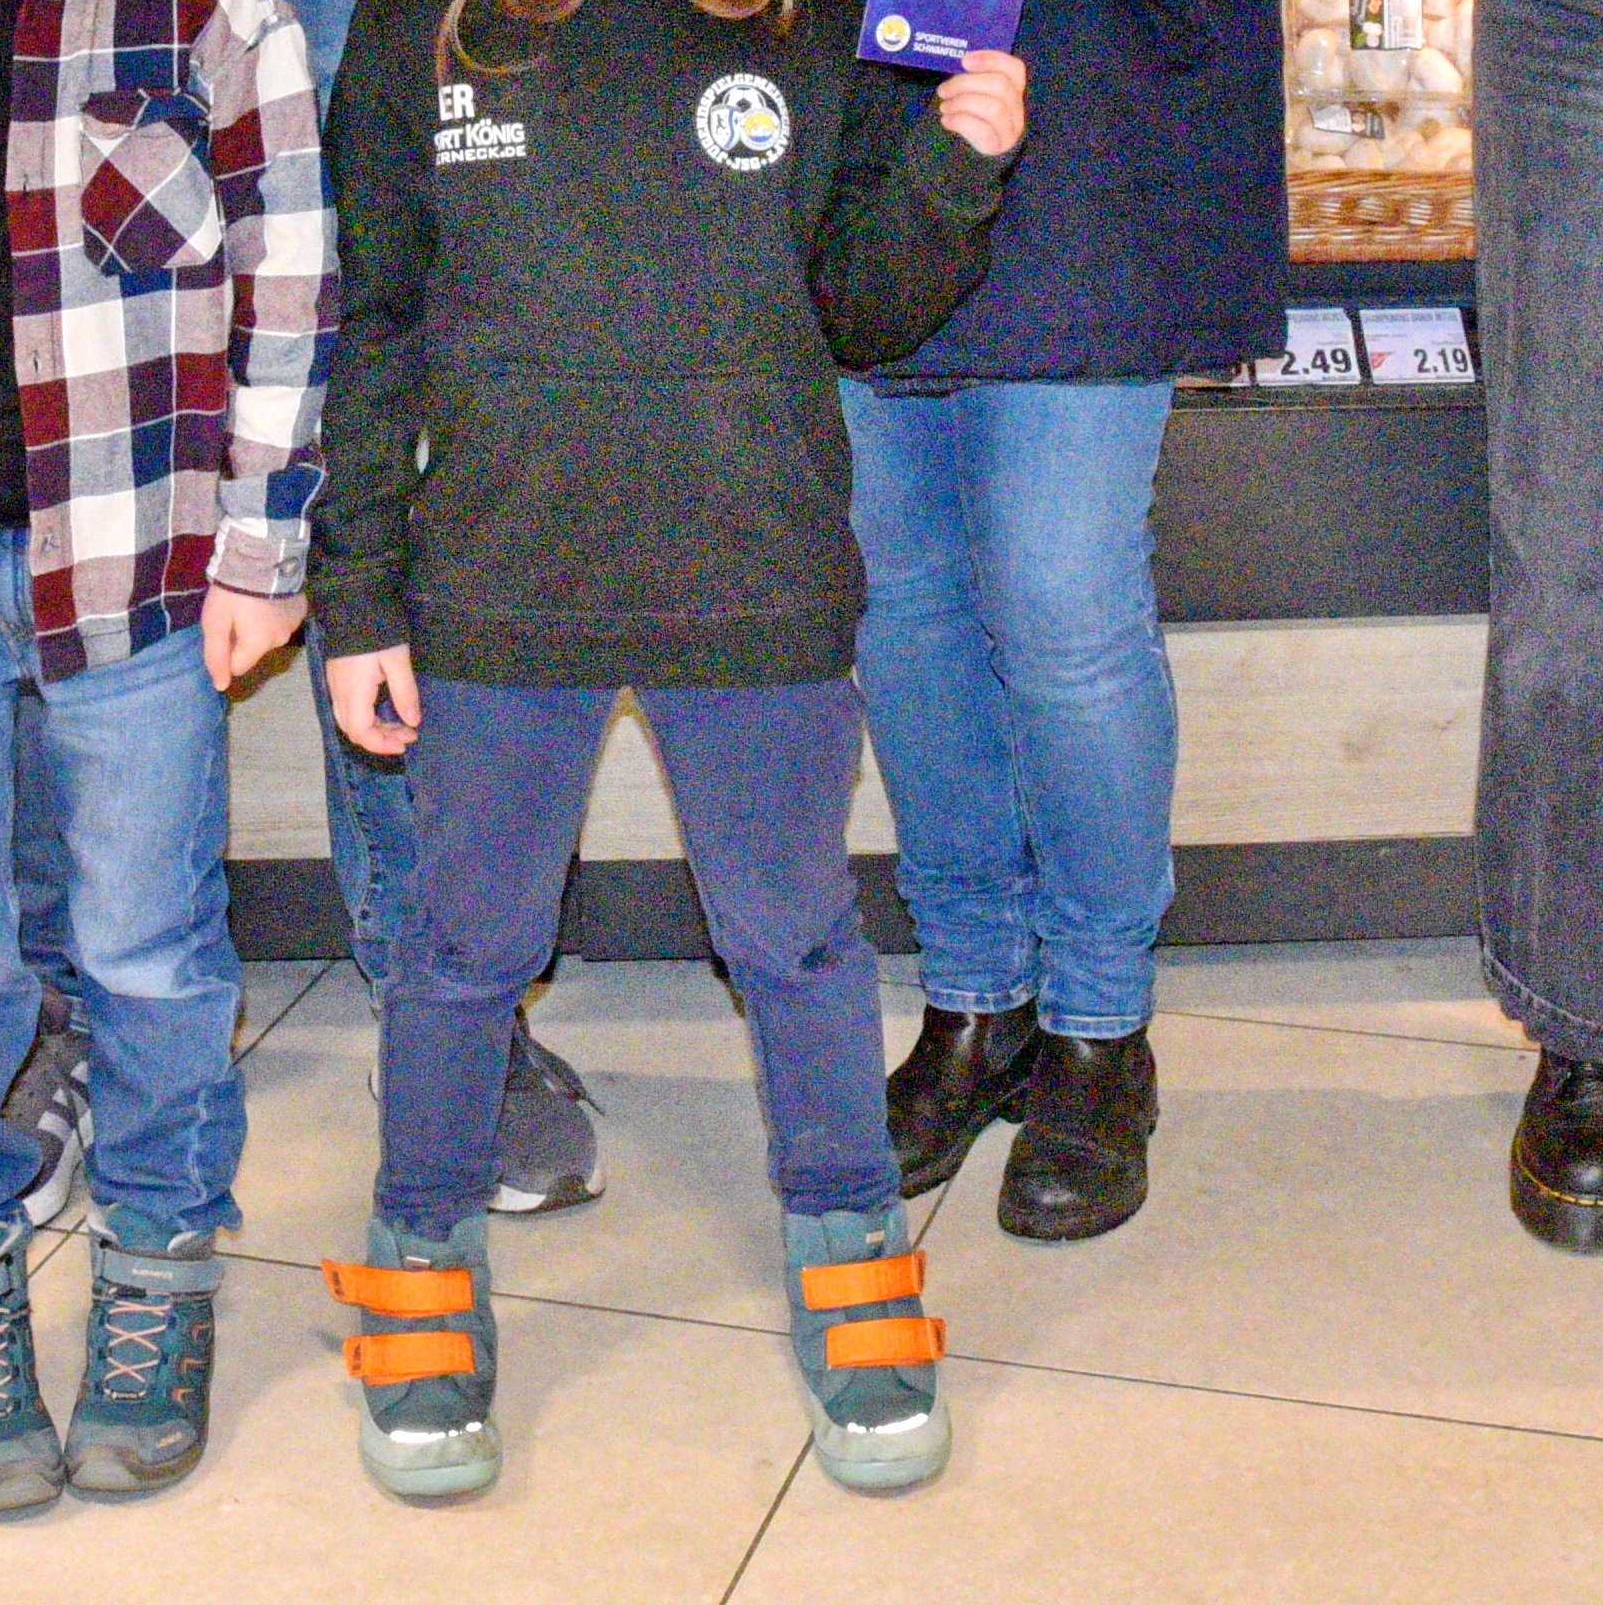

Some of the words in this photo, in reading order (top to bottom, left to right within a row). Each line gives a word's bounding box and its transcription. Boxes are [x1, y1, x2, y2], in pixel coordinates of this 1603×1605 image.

[465, 117, 526, 148] KÖNIG
[731, 156, 761, 171] JSG
[1280, 347, 1352, 375] 2.49
[1413, 347, 1469, 374] 2.19
